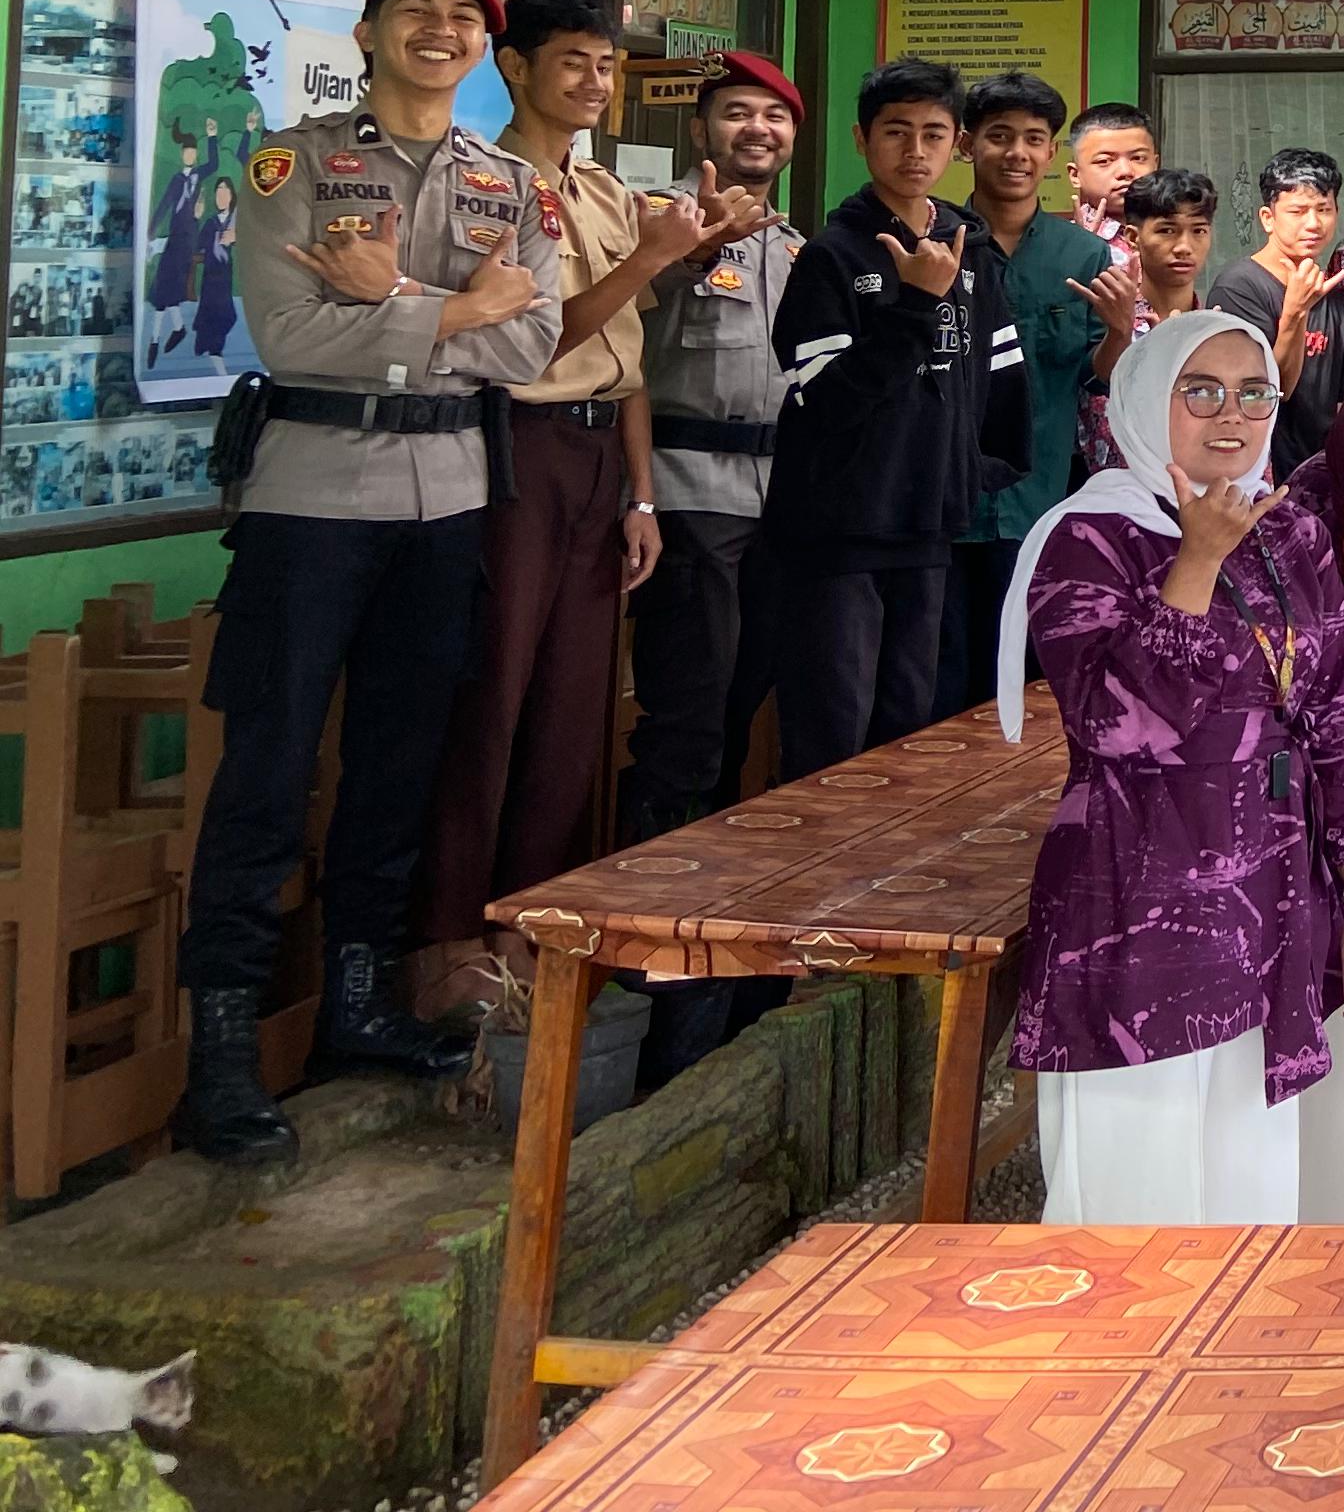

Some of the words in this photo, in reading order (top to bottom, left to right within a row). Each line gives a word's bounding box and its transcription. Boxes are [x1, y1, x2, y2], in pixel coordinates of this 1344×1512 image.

[303, 62, 353, 105] Ujian
[650, 83, 703, 98] KANT
[454, 194, 521, 224] POLRI
